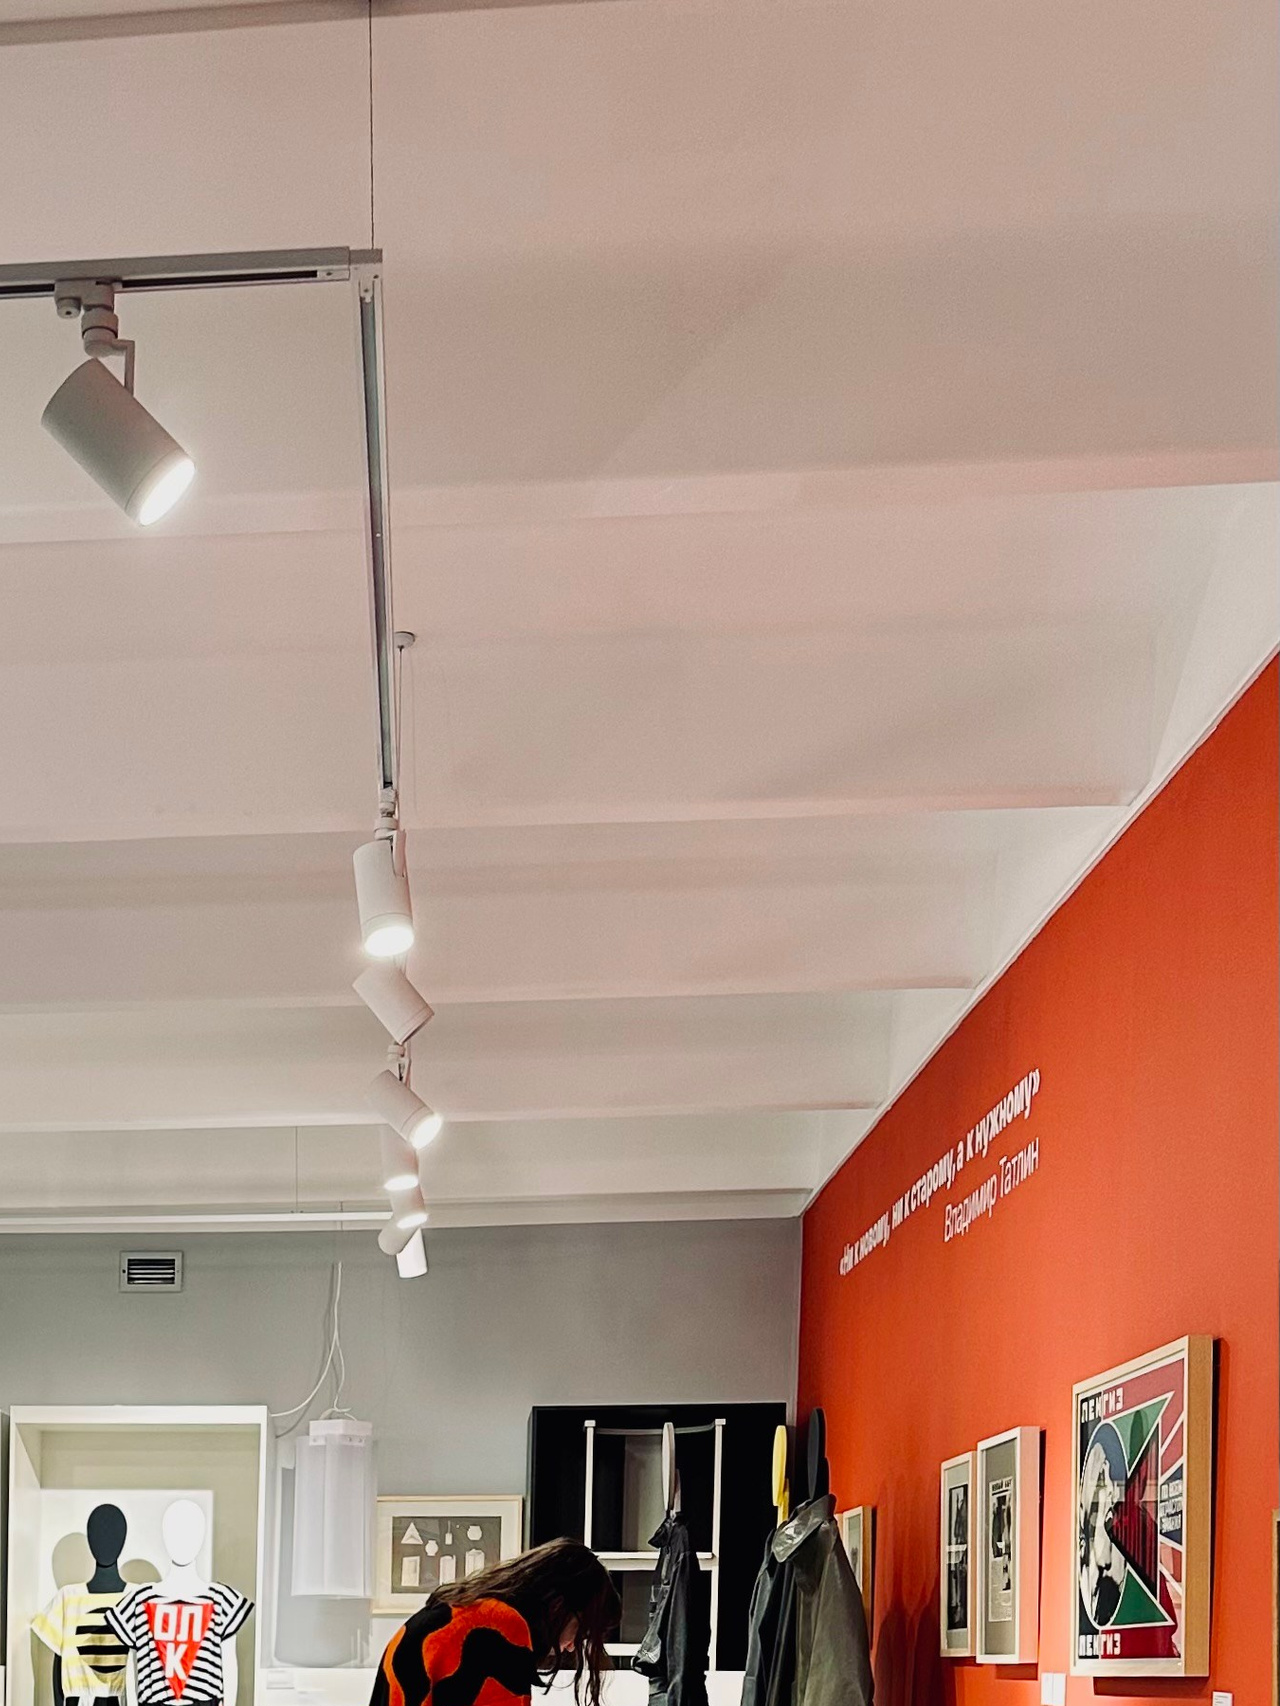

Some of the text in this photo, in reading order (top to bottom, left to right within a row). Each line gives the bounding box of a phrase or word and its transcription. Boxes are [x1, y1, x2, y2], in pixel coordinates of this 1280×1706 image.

[910, 1148, 956, 1212] старому,
[957, 1140, 964, 1172] а
[966, 1128, 975, 1162] к
[975, 1068, 1041, 1159] нужному»
[944, 1137, 1040, 1243] Владимир Татлин
